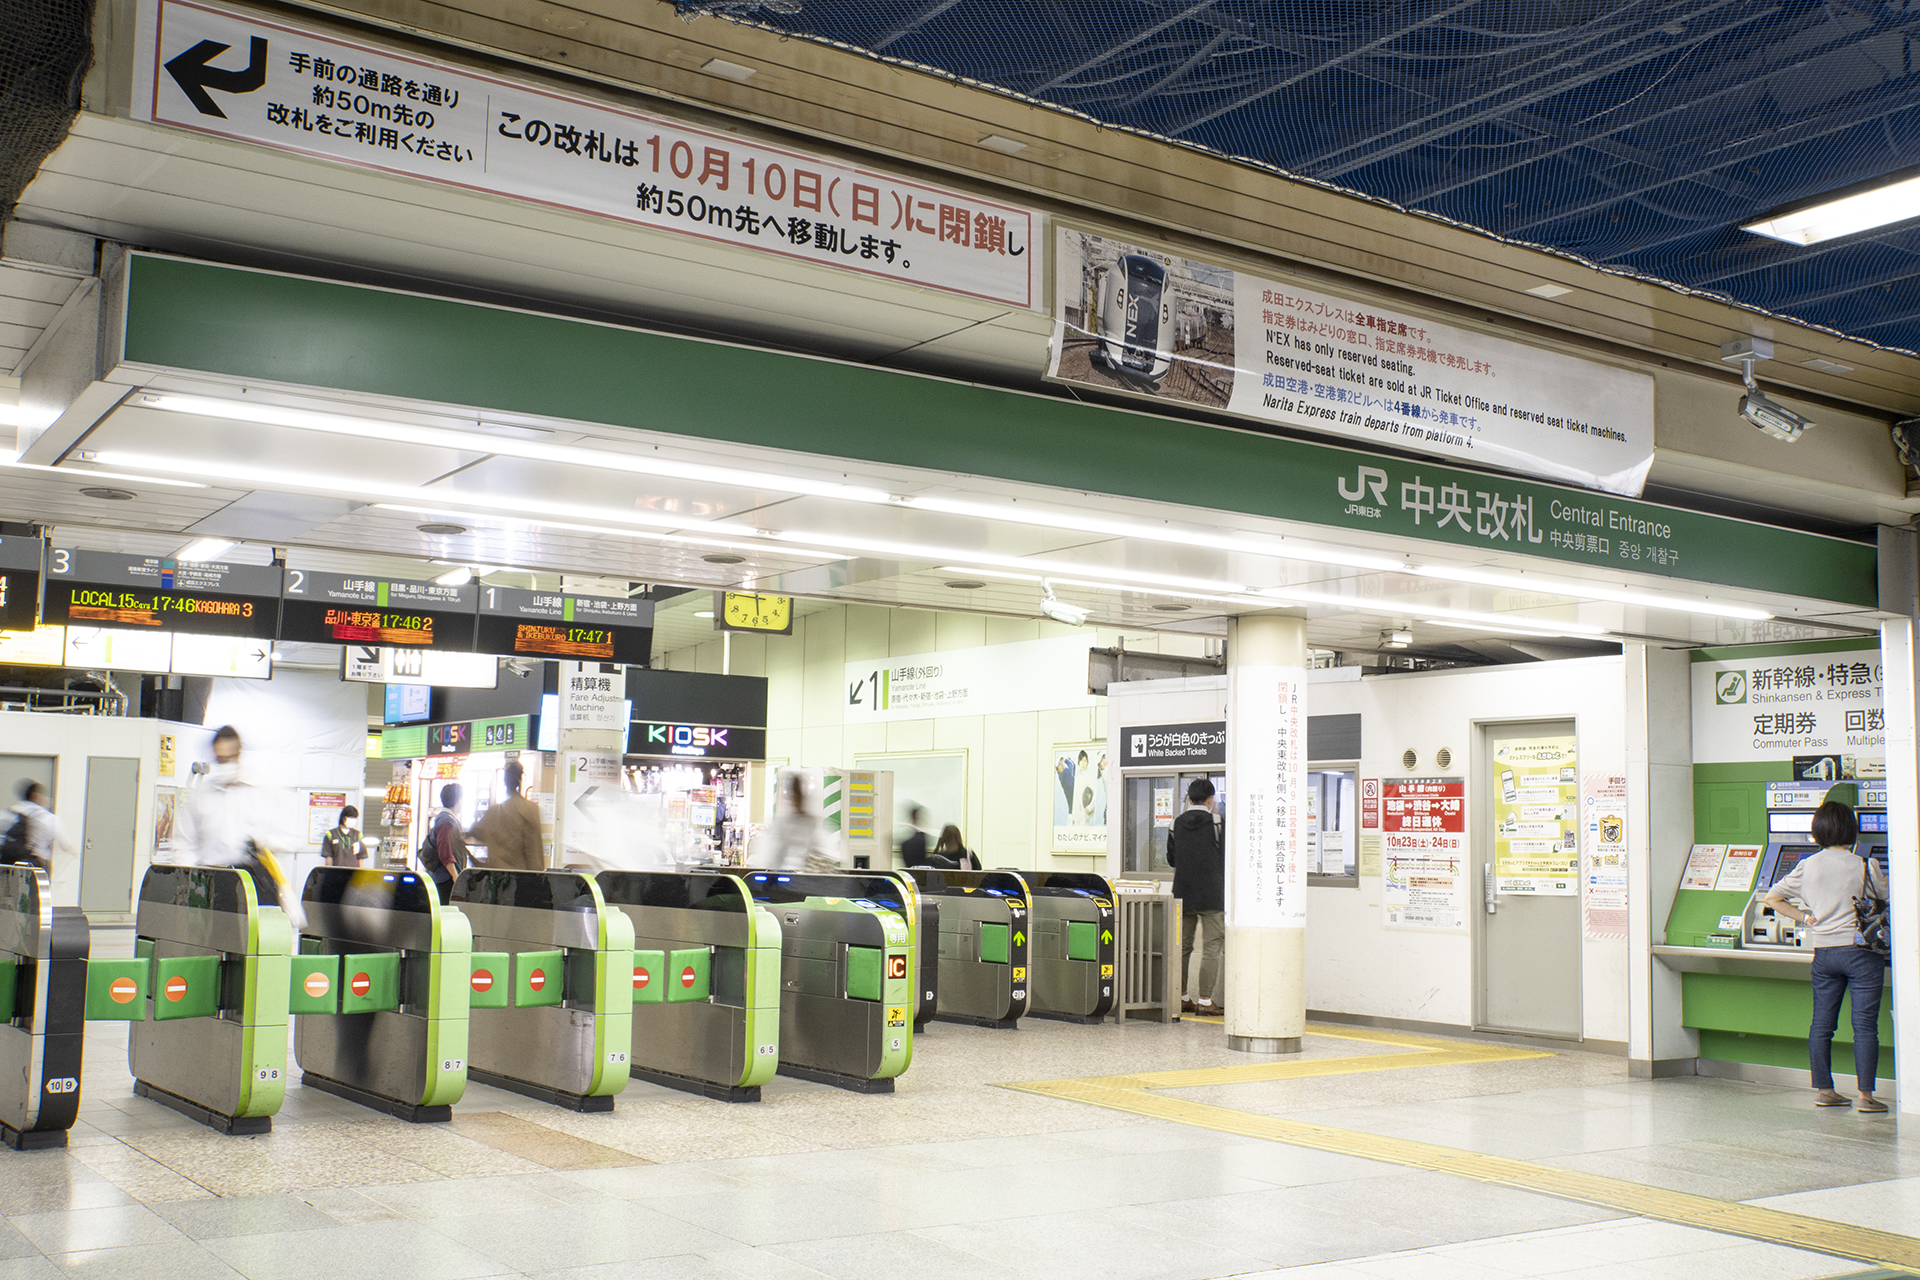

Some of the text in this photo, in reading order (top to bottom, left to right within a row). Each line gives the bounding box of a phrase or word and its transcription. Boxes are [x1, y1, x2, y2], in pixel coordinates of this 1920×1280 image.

[289, 51, 460, 109] 手前の通路を通り
[312, 84, 435, 131] 約50m先の
[267, 102, 474, 164] 改札をご利用ください
[636, 183, 911, 269] 約50m先へ移動します。
[1262, 290, 1431, 343] 成田エクスプレスは全車指定席です。
[1262, 309, 1496, 377] 指定券はみどりの窓口、指定席券売機で発売します。
[1266, 329, 1416, 376] N'EX has only reserved seating.
[1262, 372, 1482, 432] 成田空港・空港第2ビルへは4番線から発車です。
[1266, 351, 1627, 443] Reserved-seat ticket are sold at JR Ticket Office and reserved seat ticket machines.
[1263, 393, 1293, 412] Narita
[1297, 400, 1336, 420] Express
[1339, 408, 1362, 426] train
[1364, 414, 1399, 433] departs
[1402, 422, 1423, 439] from
[1425, 428, 1463, 447] platform
[1338, 465, 1388, 506] JR
[1344, 504, 1381, 518] JR東日本
[1401, 476, 1543, 544] 中央改札
[1550, 499, 1671, 539] Central Entrance
[1550, 529, 1609, 555] 中央剪票口
[1619, 540, 1679, 566] 중앙 개찰구
[52, 550, 70, 573] 3
[288, 571, 304, 593] 2
[343, 579, 375, 592] 山手線
[328, 590, 375, 601] Yamanote Line
[391, 583, 458, 597] 目黒・品川・東京方面
[729, 592, 735, 600] 9
[71, 589, 117, 607] LOCAL
[152, 596, 196, 613] 17:46
[195, 600, 240, 616] KAGOHARA
[242, 602, 253, 618] 3
[486, 587, 496, 609] 1
[533, 595, 562, 608] 山手線
[576, 598, 637, 612] 新宿・池袋・上野方面
[519, 606, 562, 616] Yamanote Line
[733, 605, 739, 613] 8
[382, 614, 433, 631] 17:46 2
[742, 613, 748, 621] 7
[752, 617, 758, 625] 6
[762, 615, 769, 623] 5
[517, 624, 556, 634] SHINJUKU
[567, 629, 612, 644] 17:47 1
[524, 633, 566, 641] IKEBUKURO
[891, 665, 943, 682] 山手線(外回り)
[1752, 662, 1883, 691] 新幹線・特急(
[570, 677, 611, 691] 精算機
[869, 670, 878, 711] 1
[891, 682, 926, 692] Yamanote Line
[571, 693, 589, 701] Fare
[1752, 692, 1812, 704] Shinkansen
[1816, 690, 1823, 700] &
[1827, 689, 1871, 702] Express
[570, 703, 605, 711] Machine
[1753, 711, 1817, 735] 定期券
[432, 725, 466, 743] KIOSK
[648, 725, 728, 747] KIOSK
[1148, 731, 1225, 747] うらが白色のきっぷ
[1753, 735, 1885, 749] Commuter Pass Multiple
[1148, 748, 1207, 757] White Backed Tickets
[578, 757, 587, 772] 2
[1413, 800, 1431, 811] 渋谷
[1440, 799, 1460, 811] 大崎
[1402, 816, 1442, 827] 終日運休
[889, 933, 905, 943] 専用
[889, 958, 905, 977] IC
[760, 1045, 774, 1054] 6 5
[893, 1039, 899, 1048] 5
[444, 1060, 461, 1070] 8 7
[610, 1053, 625, 1062] 7 6
[260, 1069, 278, 1080] 9 8
[50, 1080, 72, 1091] 10 9
